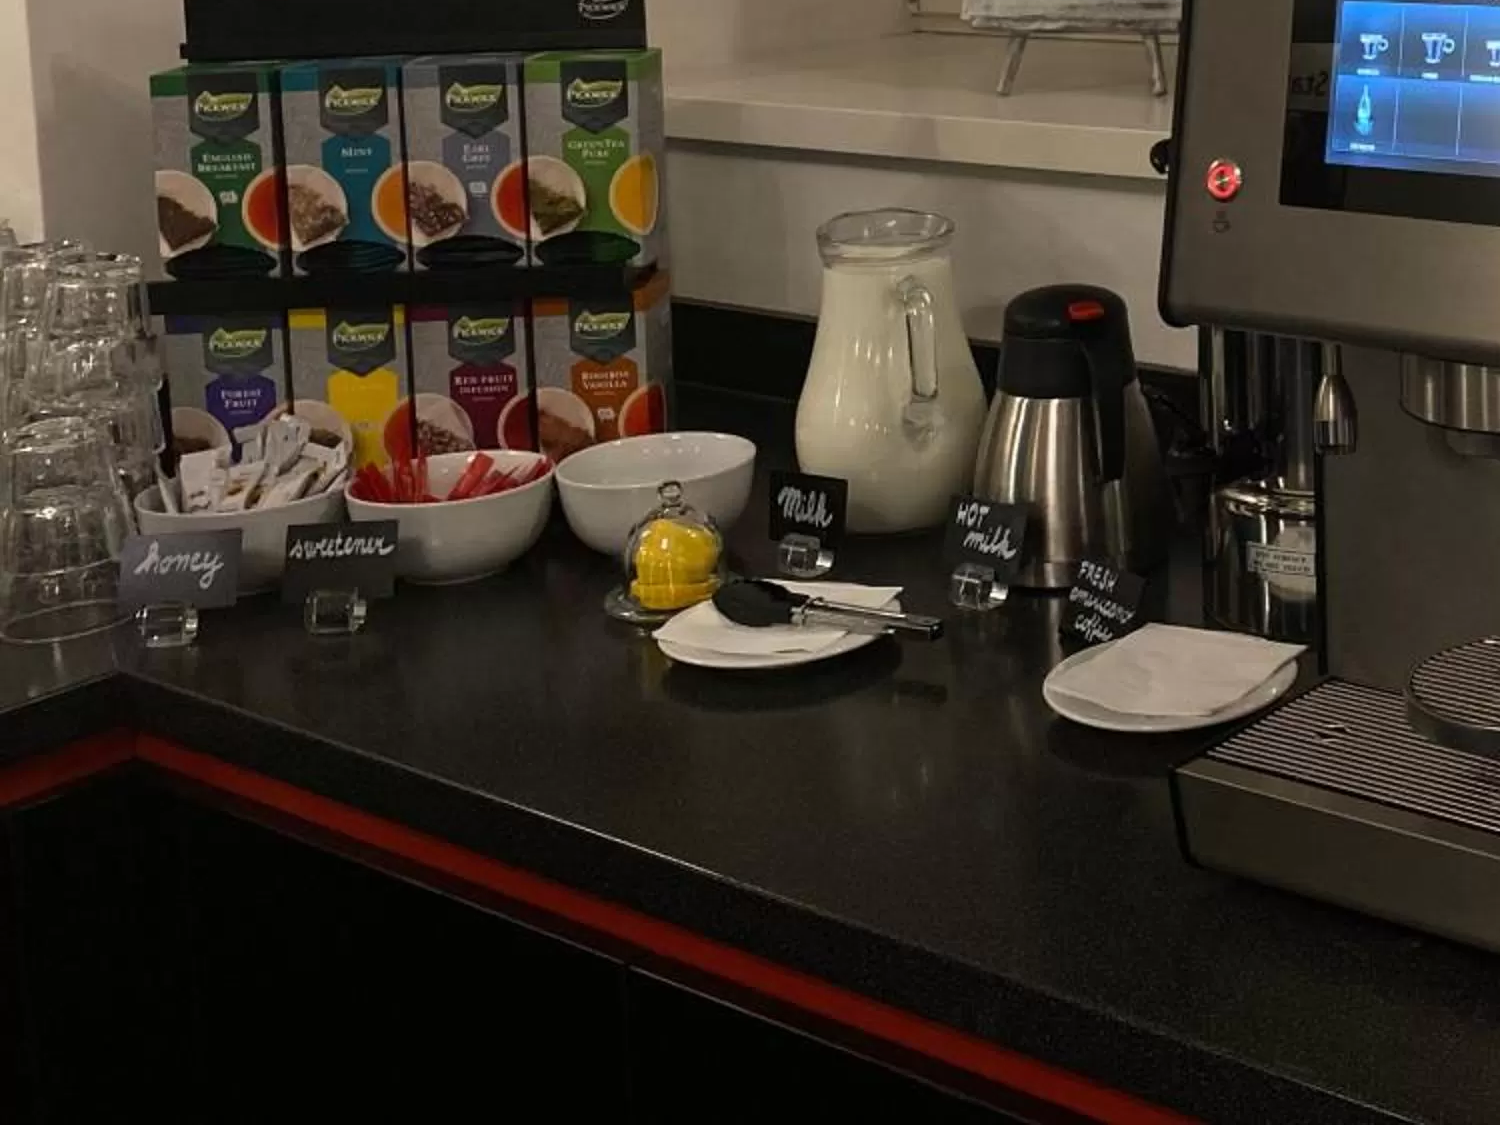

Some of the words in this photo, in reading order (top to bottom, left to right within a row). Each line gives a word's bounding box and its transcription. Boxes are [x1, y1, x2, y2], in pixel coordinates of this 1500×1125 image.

[956, 502, 990, 527] HOT
[289, 531, 395, 559] sweetener
[963, 525, 1017, 560] milk
[133, 539, 224, 589] honey
